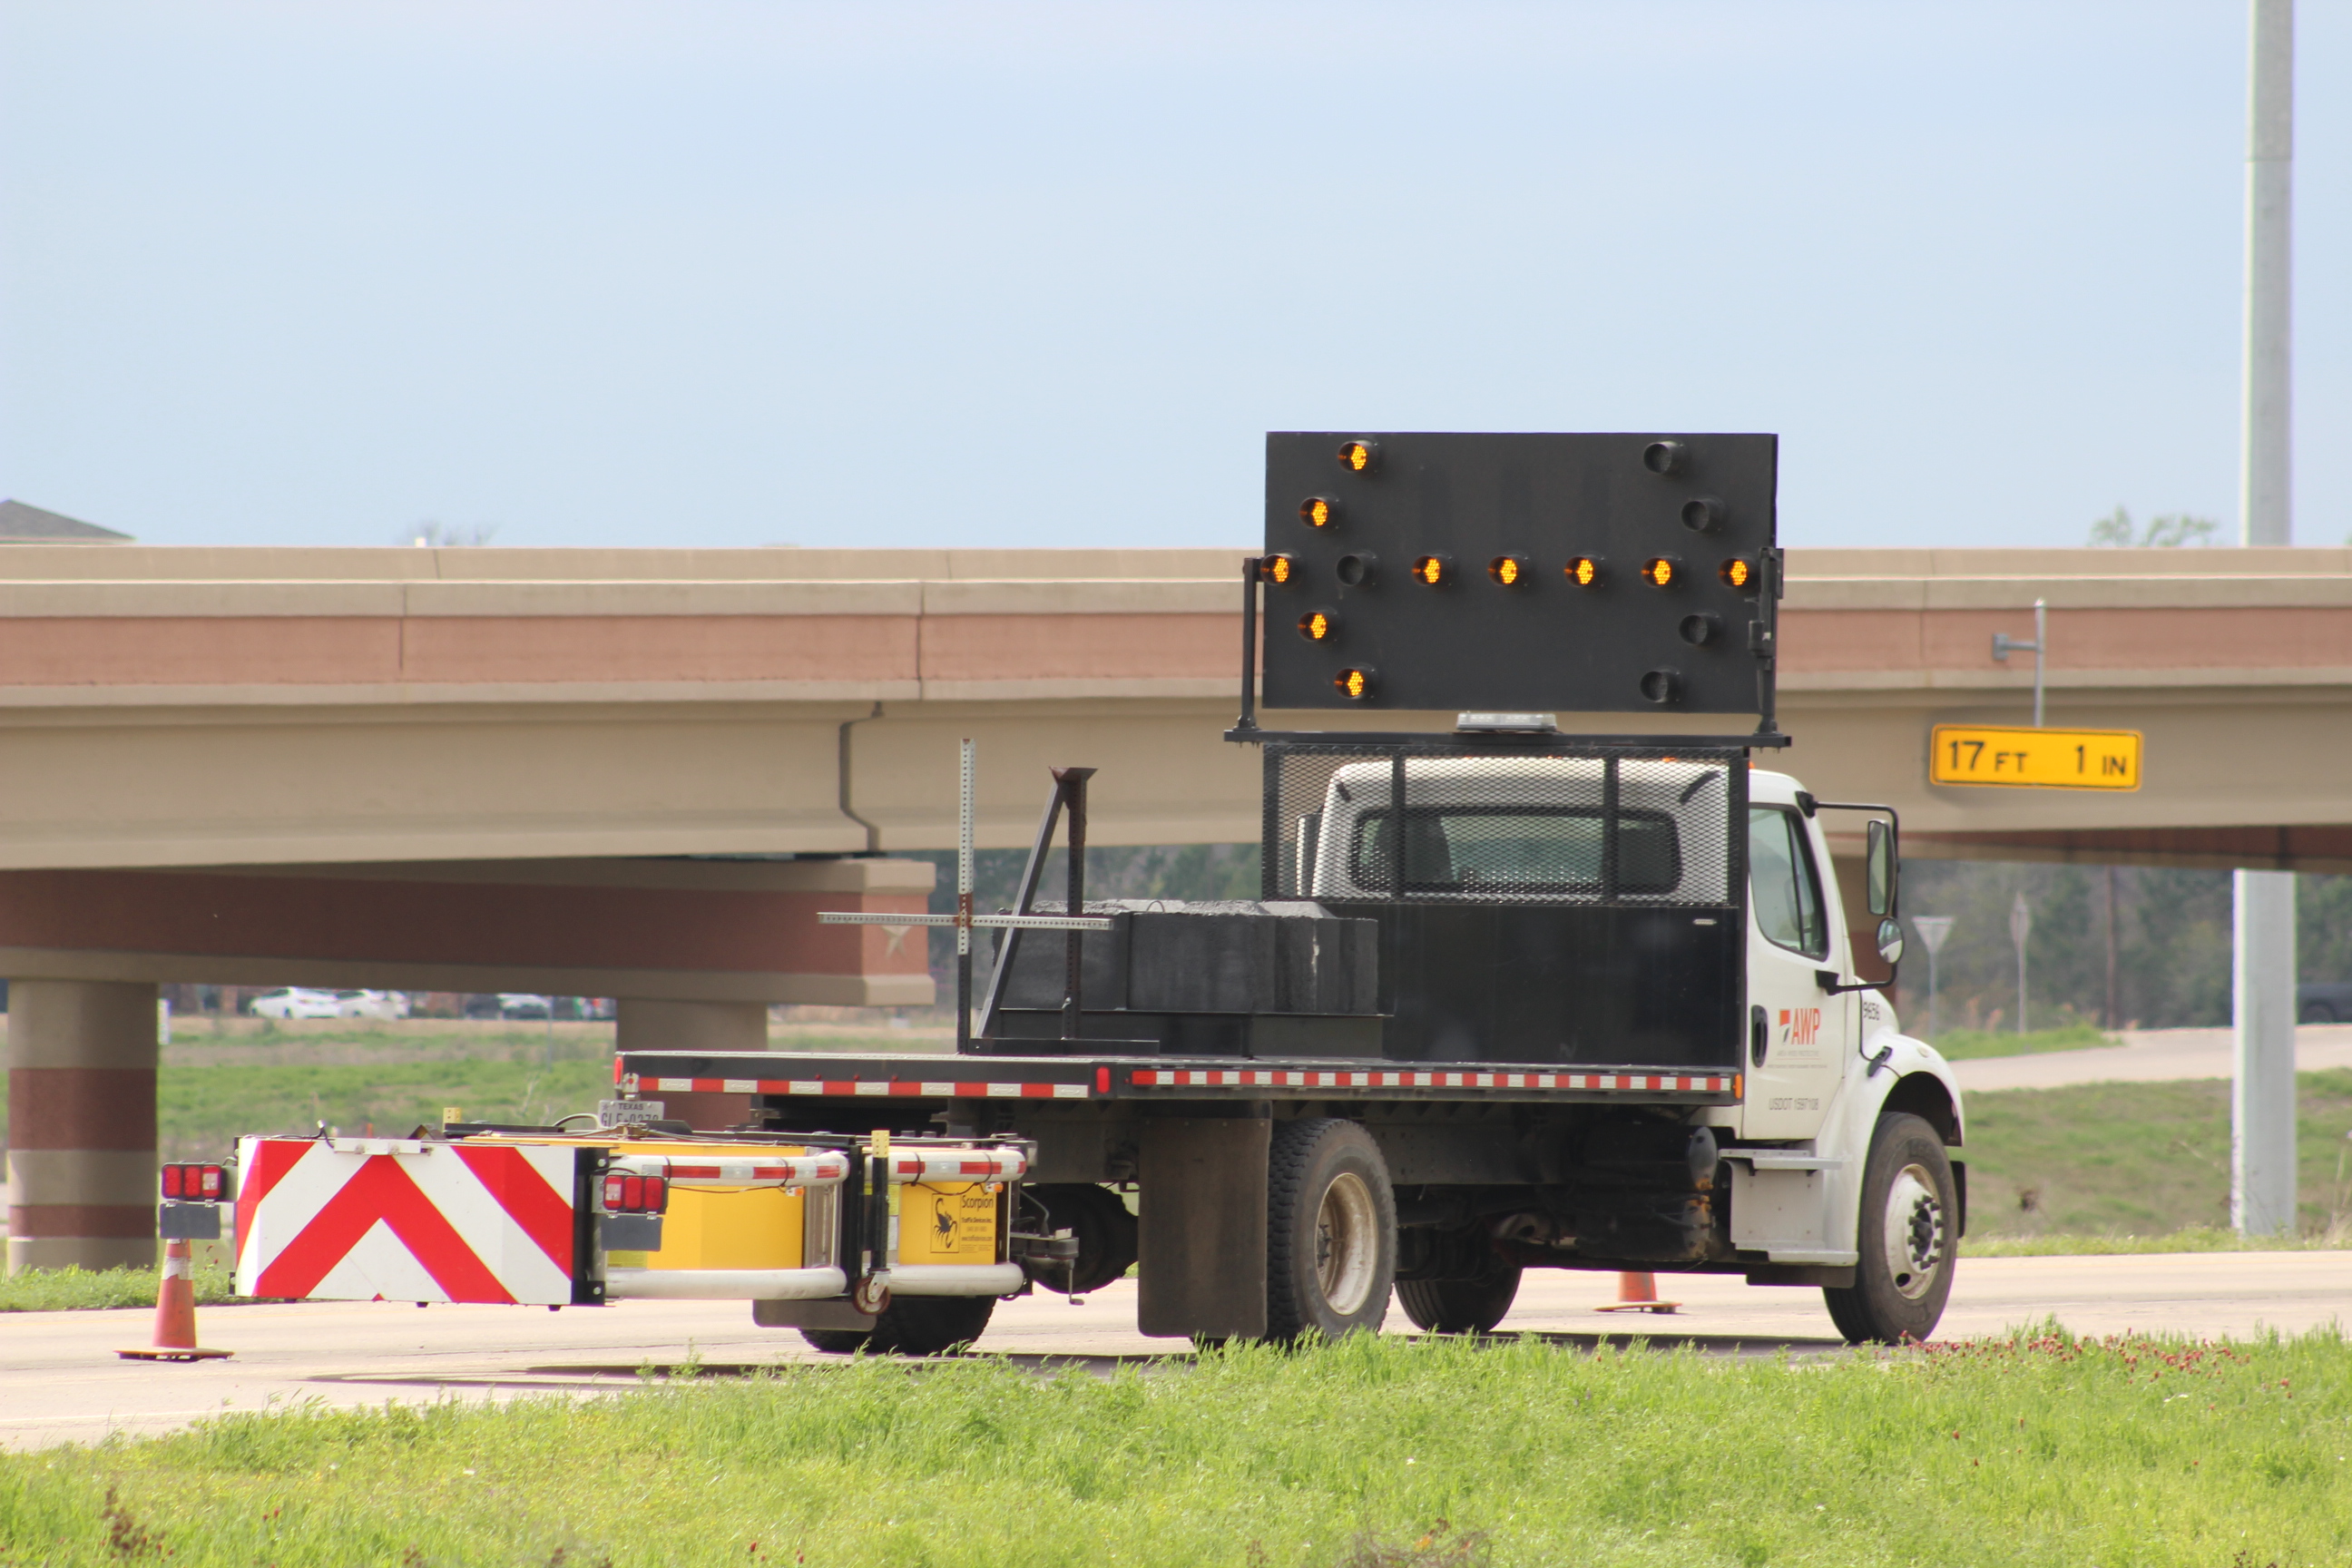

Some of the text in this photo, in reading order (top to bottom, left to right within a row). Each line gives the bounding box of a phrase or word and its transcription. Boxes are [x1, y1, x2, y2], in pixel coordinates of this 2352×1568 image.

[1948, 740, 2126, 777] 17 FT 1 IN
[1791, 1007, 1821, 1045] AWP
[619, 1102, 644, 1111] TEXAS
[1769, 1097, 1793, 1111] USDOT
[962, 1195, 994, 1211] Scorpion
